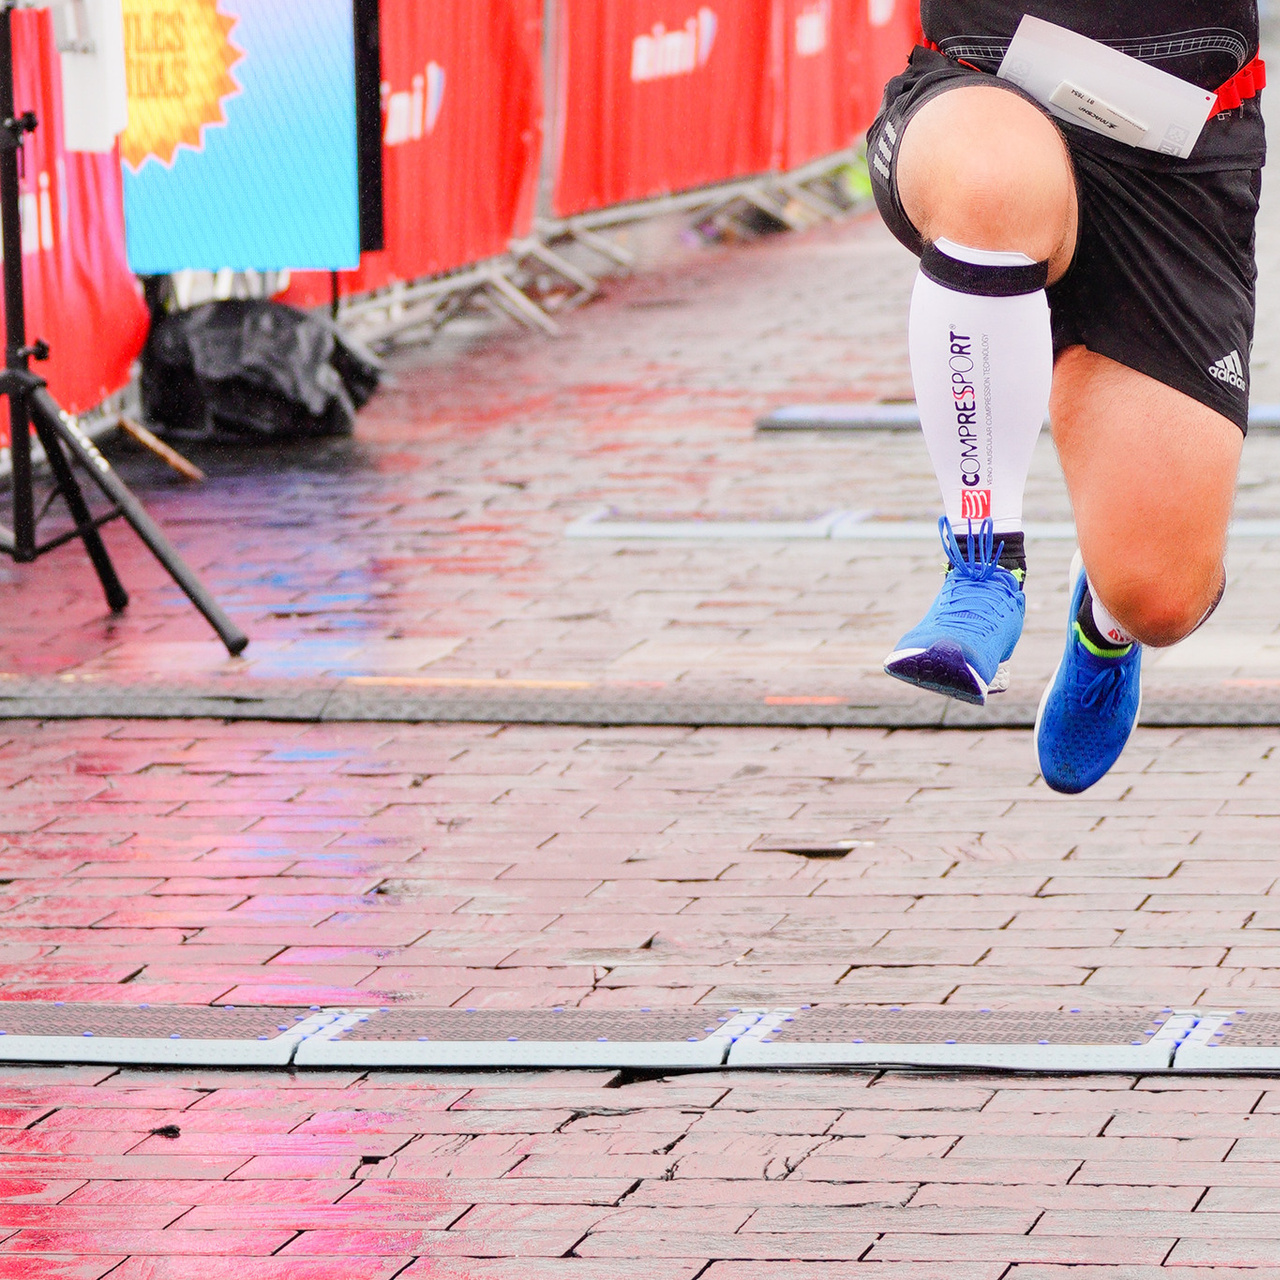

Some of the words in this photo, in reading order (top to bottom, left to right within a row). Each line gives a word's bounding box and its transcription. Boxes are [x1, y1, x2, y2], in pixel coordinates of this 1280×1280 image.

[981, 333, 991, 376] TECHNOLOGY
[1208, 365, 1247, 392] adidas
[983, 376, 993, 426] COMPRESSION
[985, 426, 994, 466] MUSCULAR
